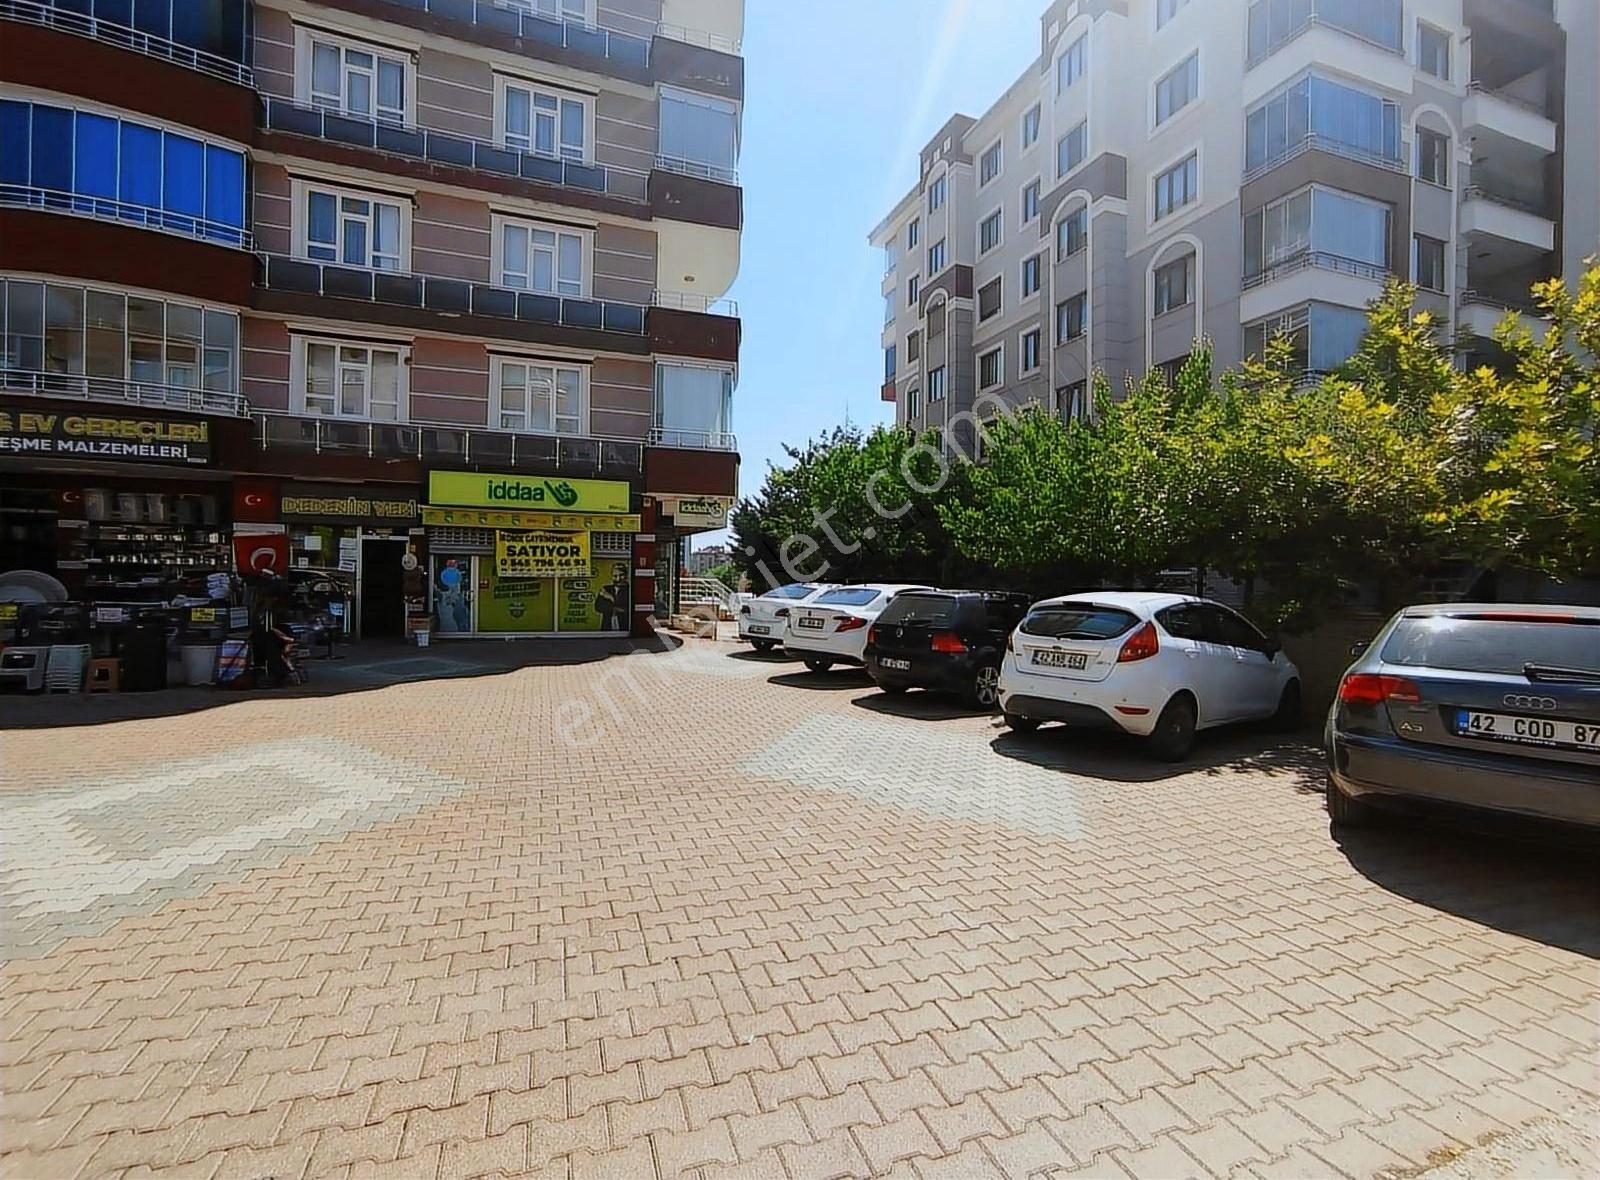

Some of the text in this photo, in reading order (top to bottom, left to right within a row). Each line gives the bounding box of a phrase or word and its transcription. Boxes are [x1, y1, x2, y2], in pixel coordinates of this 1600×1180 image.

[19, 413, 57, 434] EV
[63, 416, 208, 444] GEREÇLERİ
[57, 440, 188, 458] MALZEMELERİ
[488, 480, 545, 502] iddaa
[282, 496, 370, 517] DEDENİN
[506, 545, 581, 558] SATIYOR
[1401, 722, 1423, 732] A3
[1470, 715, 1496, 732] 42
[1514, 719, 1556, 739] COD
